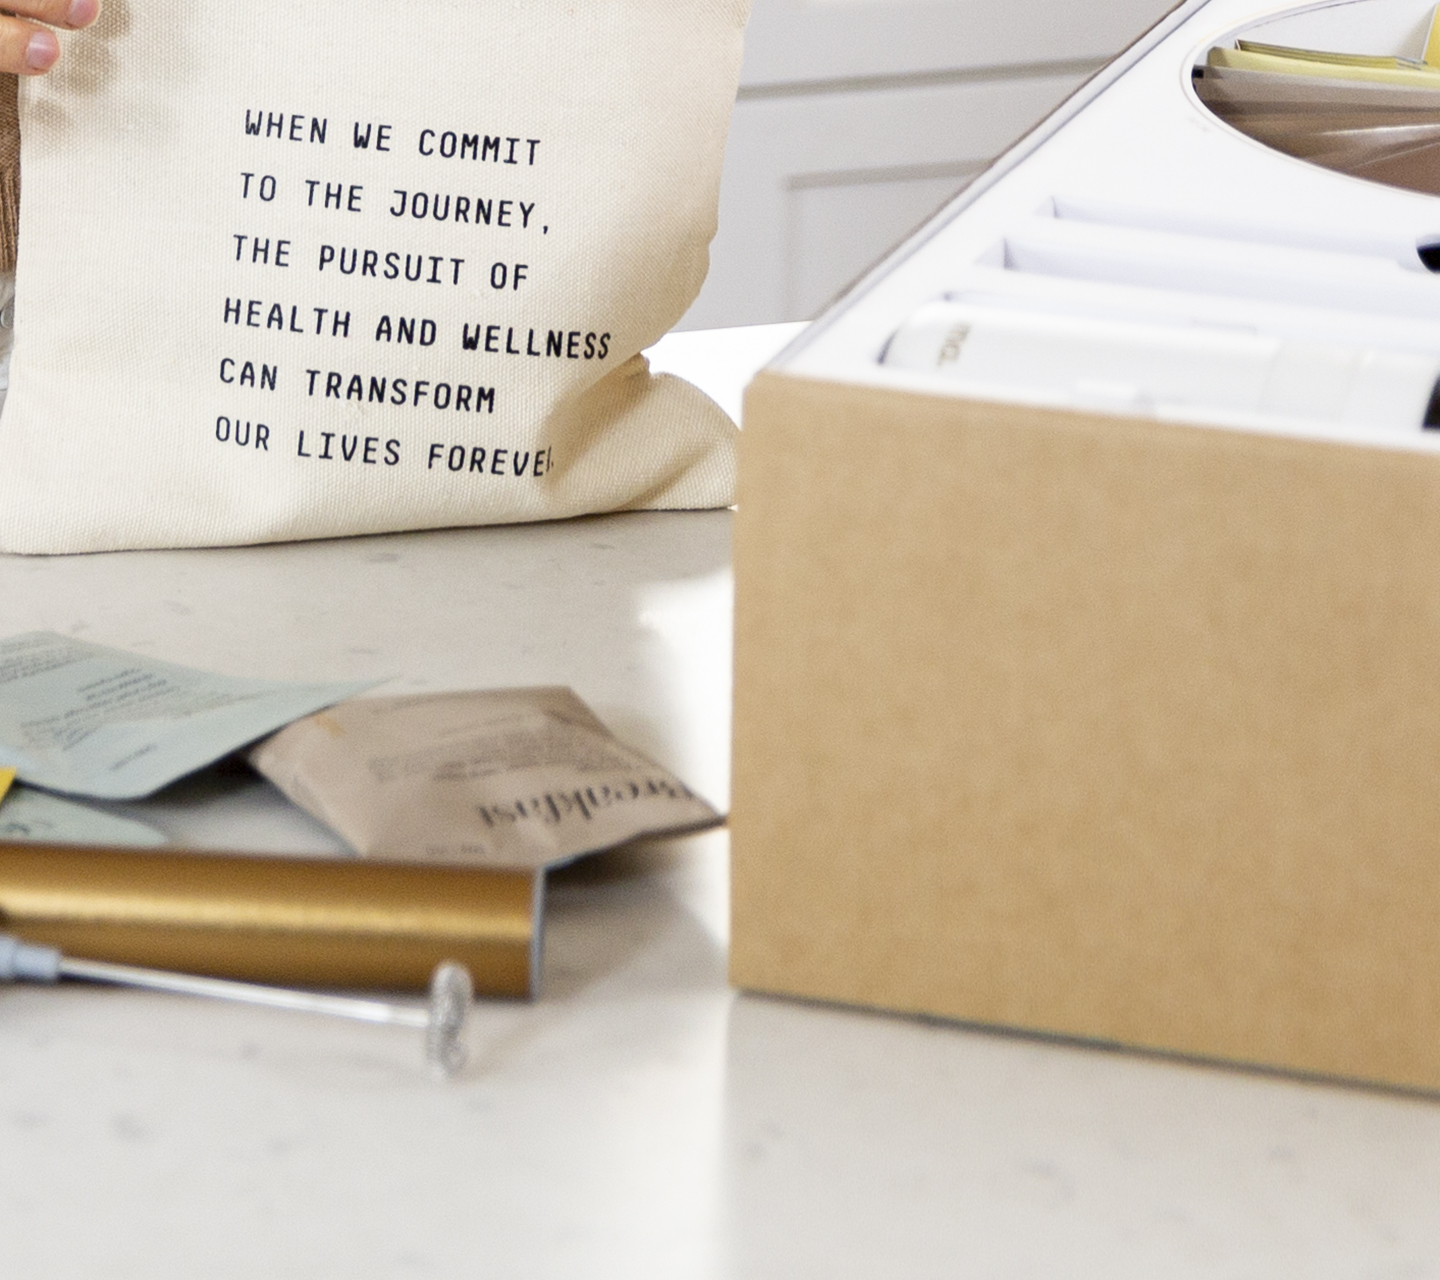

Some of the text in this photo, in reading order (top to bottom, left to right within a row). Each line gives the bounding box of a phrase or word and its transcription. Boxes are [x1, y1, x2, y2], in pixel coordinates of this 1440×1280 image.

[244, 109, 541, 166] WHEN WE COMMIT
[240, 172, 549, 235] TO THE JOURNEY,
[233, 234, 529, 291] THE PURSUIT OF
[223, 297, 612, 360] HEALTH AND WELLNESS
[219, 357, 496, 414] CAN TRANSFORM
[215, 416, 270, 451] OUR
[297, 430, 401, 466] LIVES
